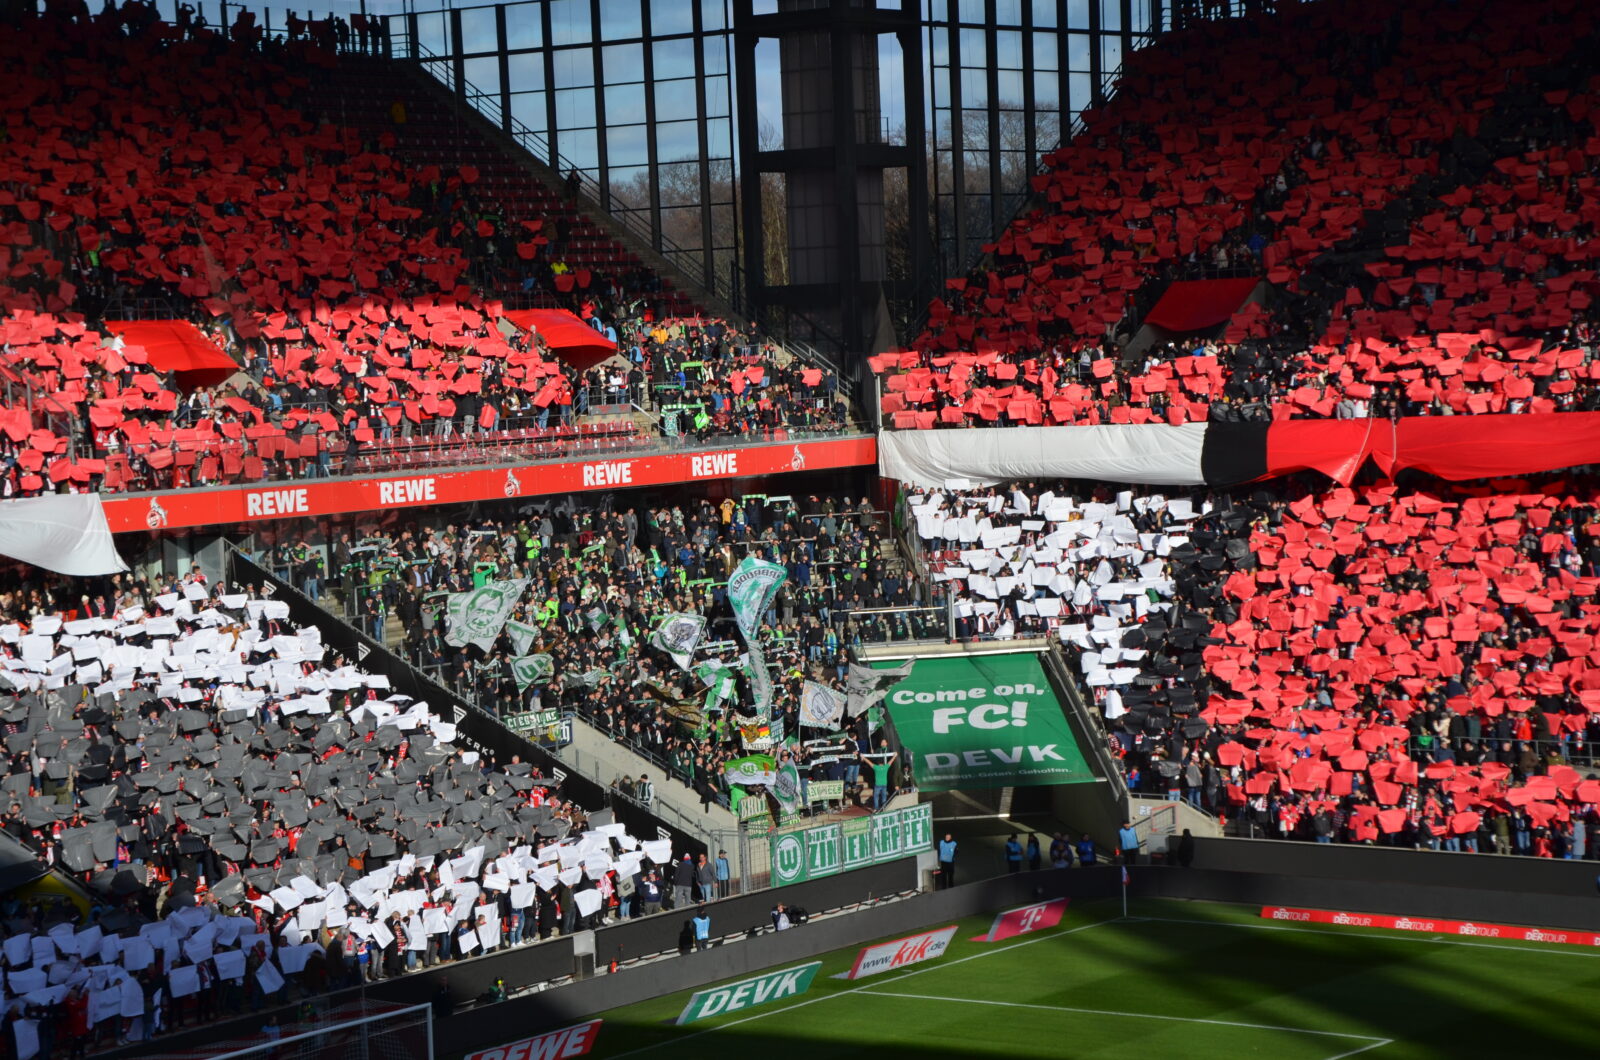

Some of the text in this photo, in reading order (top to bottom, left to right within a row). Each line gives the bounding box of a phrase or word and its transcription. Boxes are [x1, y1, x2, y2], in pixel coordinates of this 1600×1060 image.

[583, 461, 632, 486] REWE
[692, 453, 737, 476] REWE
[248, 489, 308, 516] REWE
[380, 478, 436, 504] REWE
[892, 684, 1045, 705] Come on,
[933, 701, 1029, 734] FC!
[924, 744, 1067, 769] DEVK
[1018, 767, 1073, 776] Geholfen.
[696, 969, 807, 1018] DEVK
